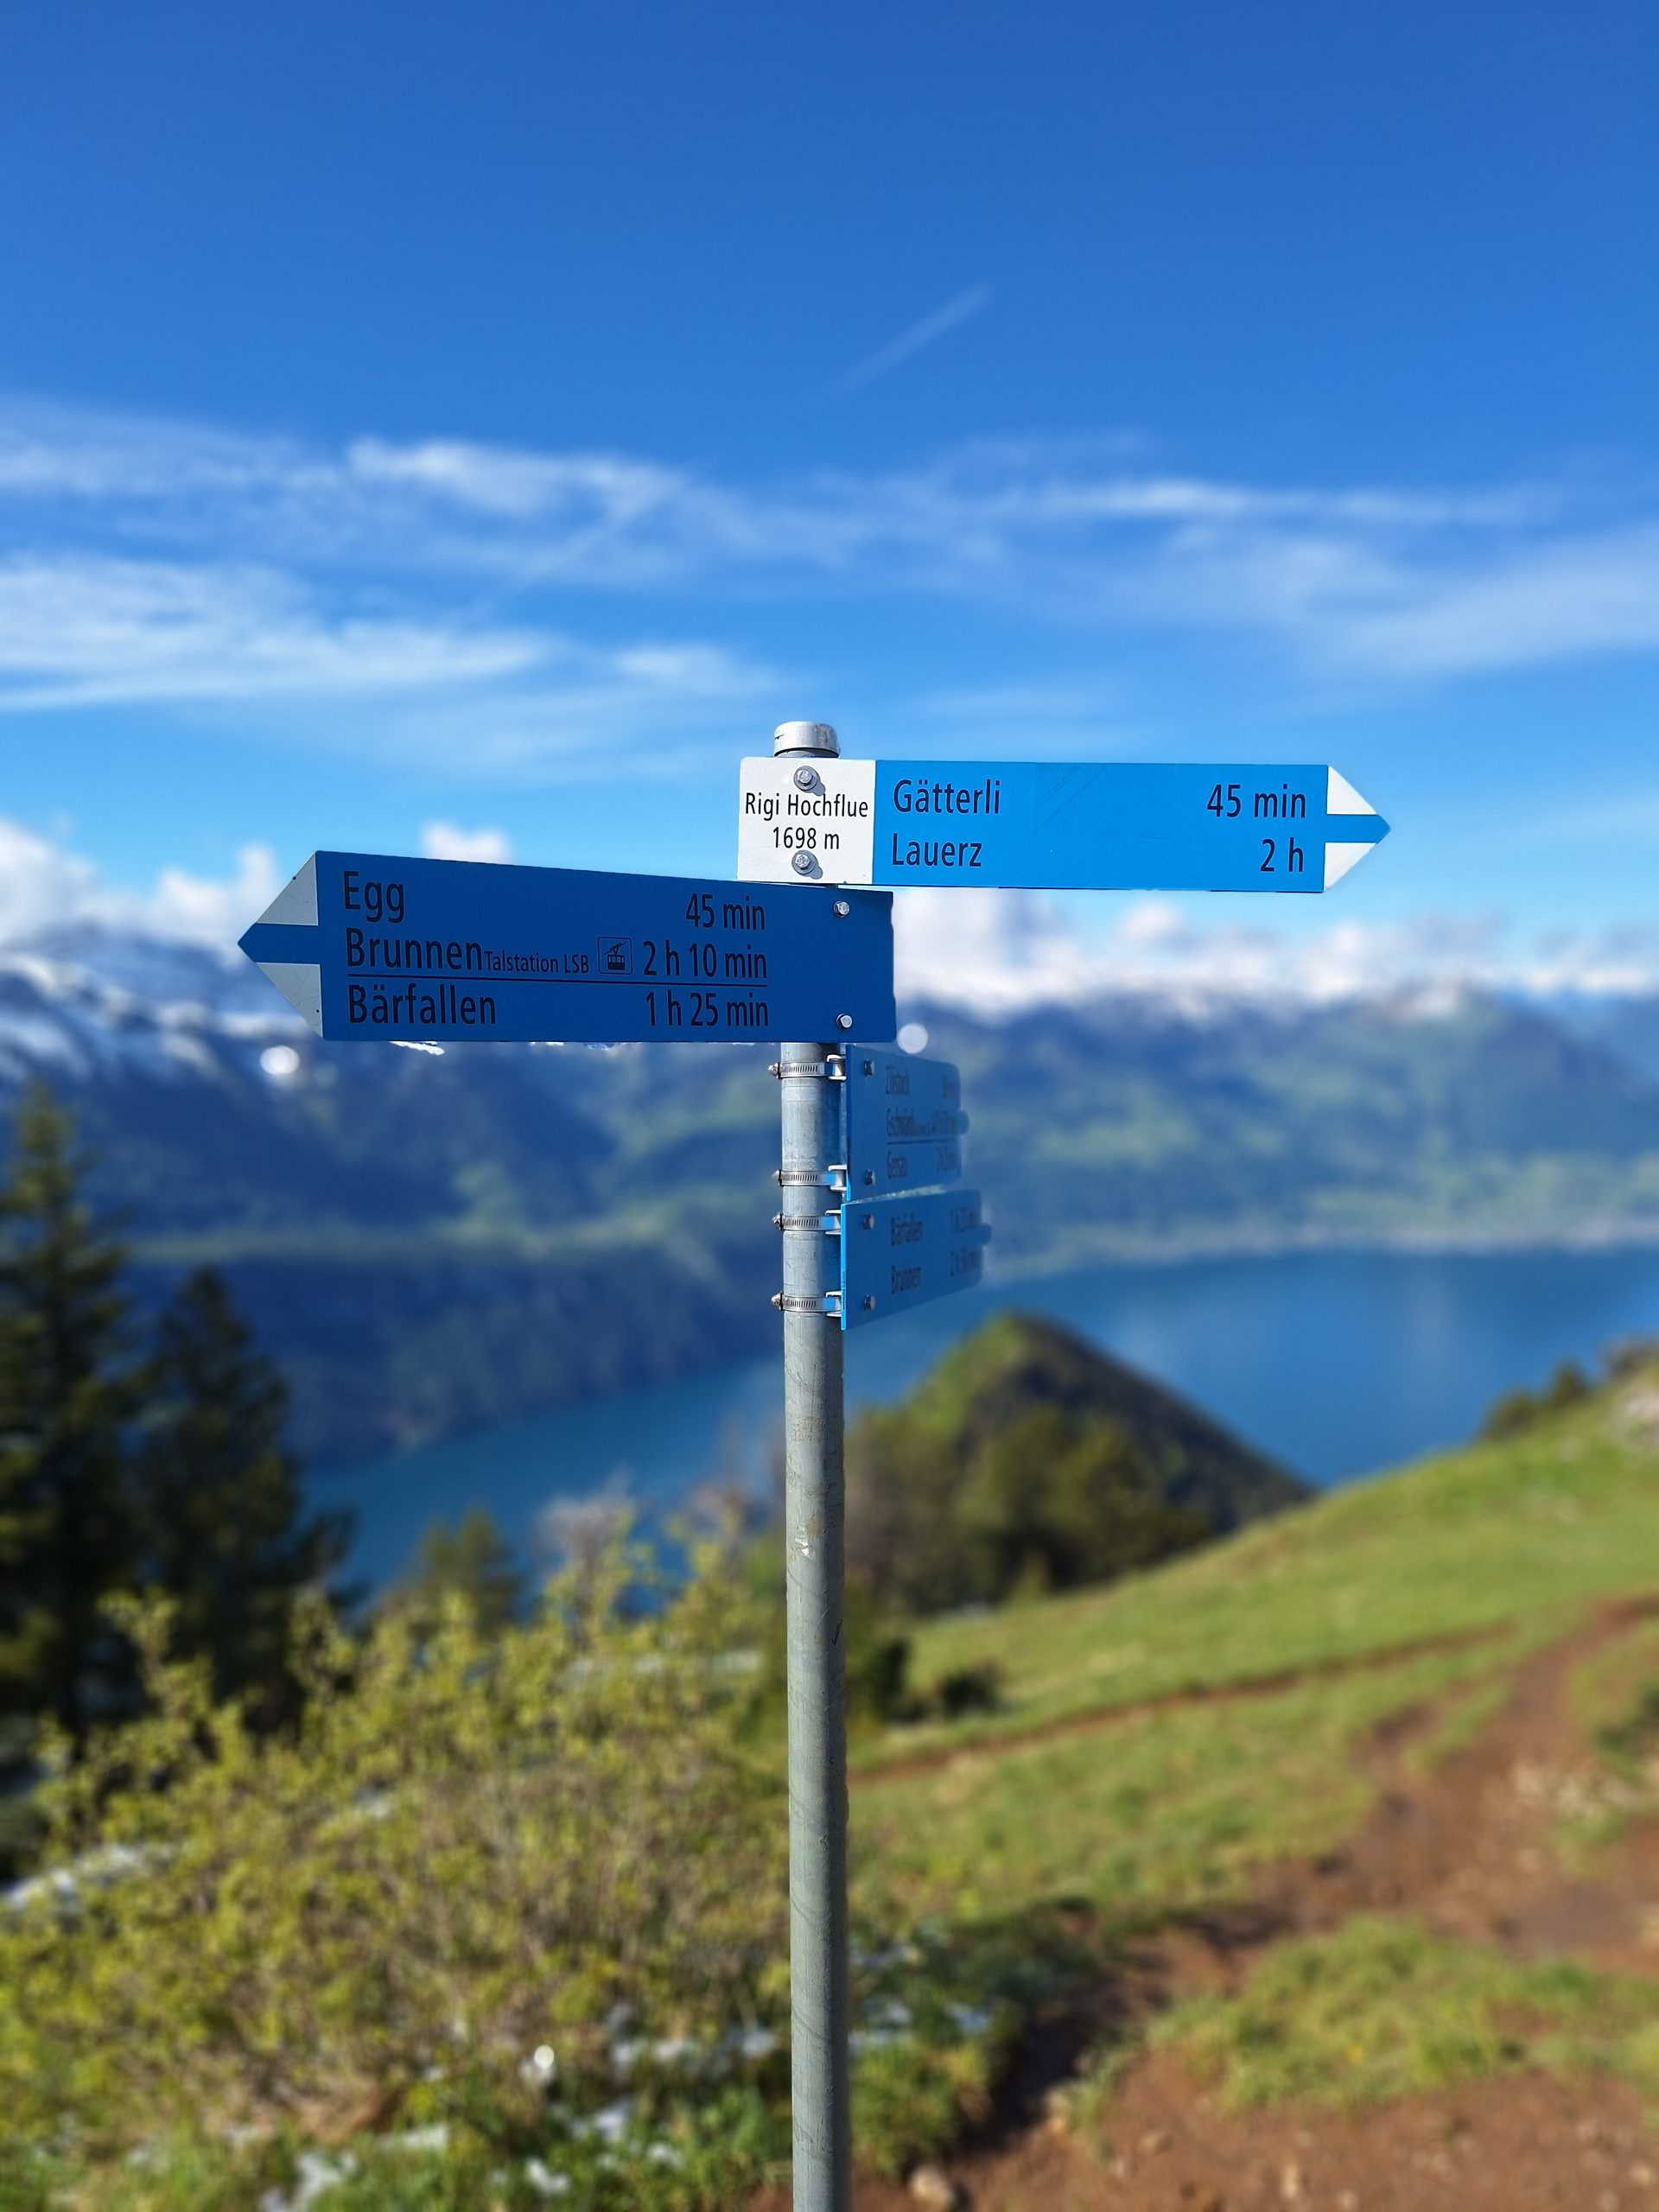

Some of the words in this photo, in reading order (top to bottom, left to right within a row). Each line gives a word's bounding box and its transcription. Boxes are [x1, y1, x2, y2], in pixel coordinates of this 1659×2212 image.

[746, 792, 779, 821] Rigi
[788, 792, 868, 817] Hochflue
[893, 779, 1001, 814] Gätterli
[1207, 785, 1242, 817] 45
[1255, 784, 1306, 817] min
[773, 826, 816, 849] 1698
[824, 833, 840, 849] m
[893, 833, 982, 868] Lauerz
[1261, 838, 1275, 871] 2
[1288, 836, 1304, 872] h
[344, 871, 404, 923] Egg
[686, 893, 715, 927] 45
[723, 896, 766, 930] min
[346, 928, 482, 971] Brunnen
[484, 950, 559, 973] Talstation
[564, 953, 589, 974] LSB
[644, 940, 658, 976] 2
[666, 939, 680, 976] h
[690, 944, 717, 977] 10
[724, 944, 767, 978] min
[349, 983, 496, 1025] Bärfallen
[646, 991, 656, 1026] 1
[667, 989, 681, 1026] h
[690, 993, 719, 1026] 25
[727, 993, 769, 1027] min
